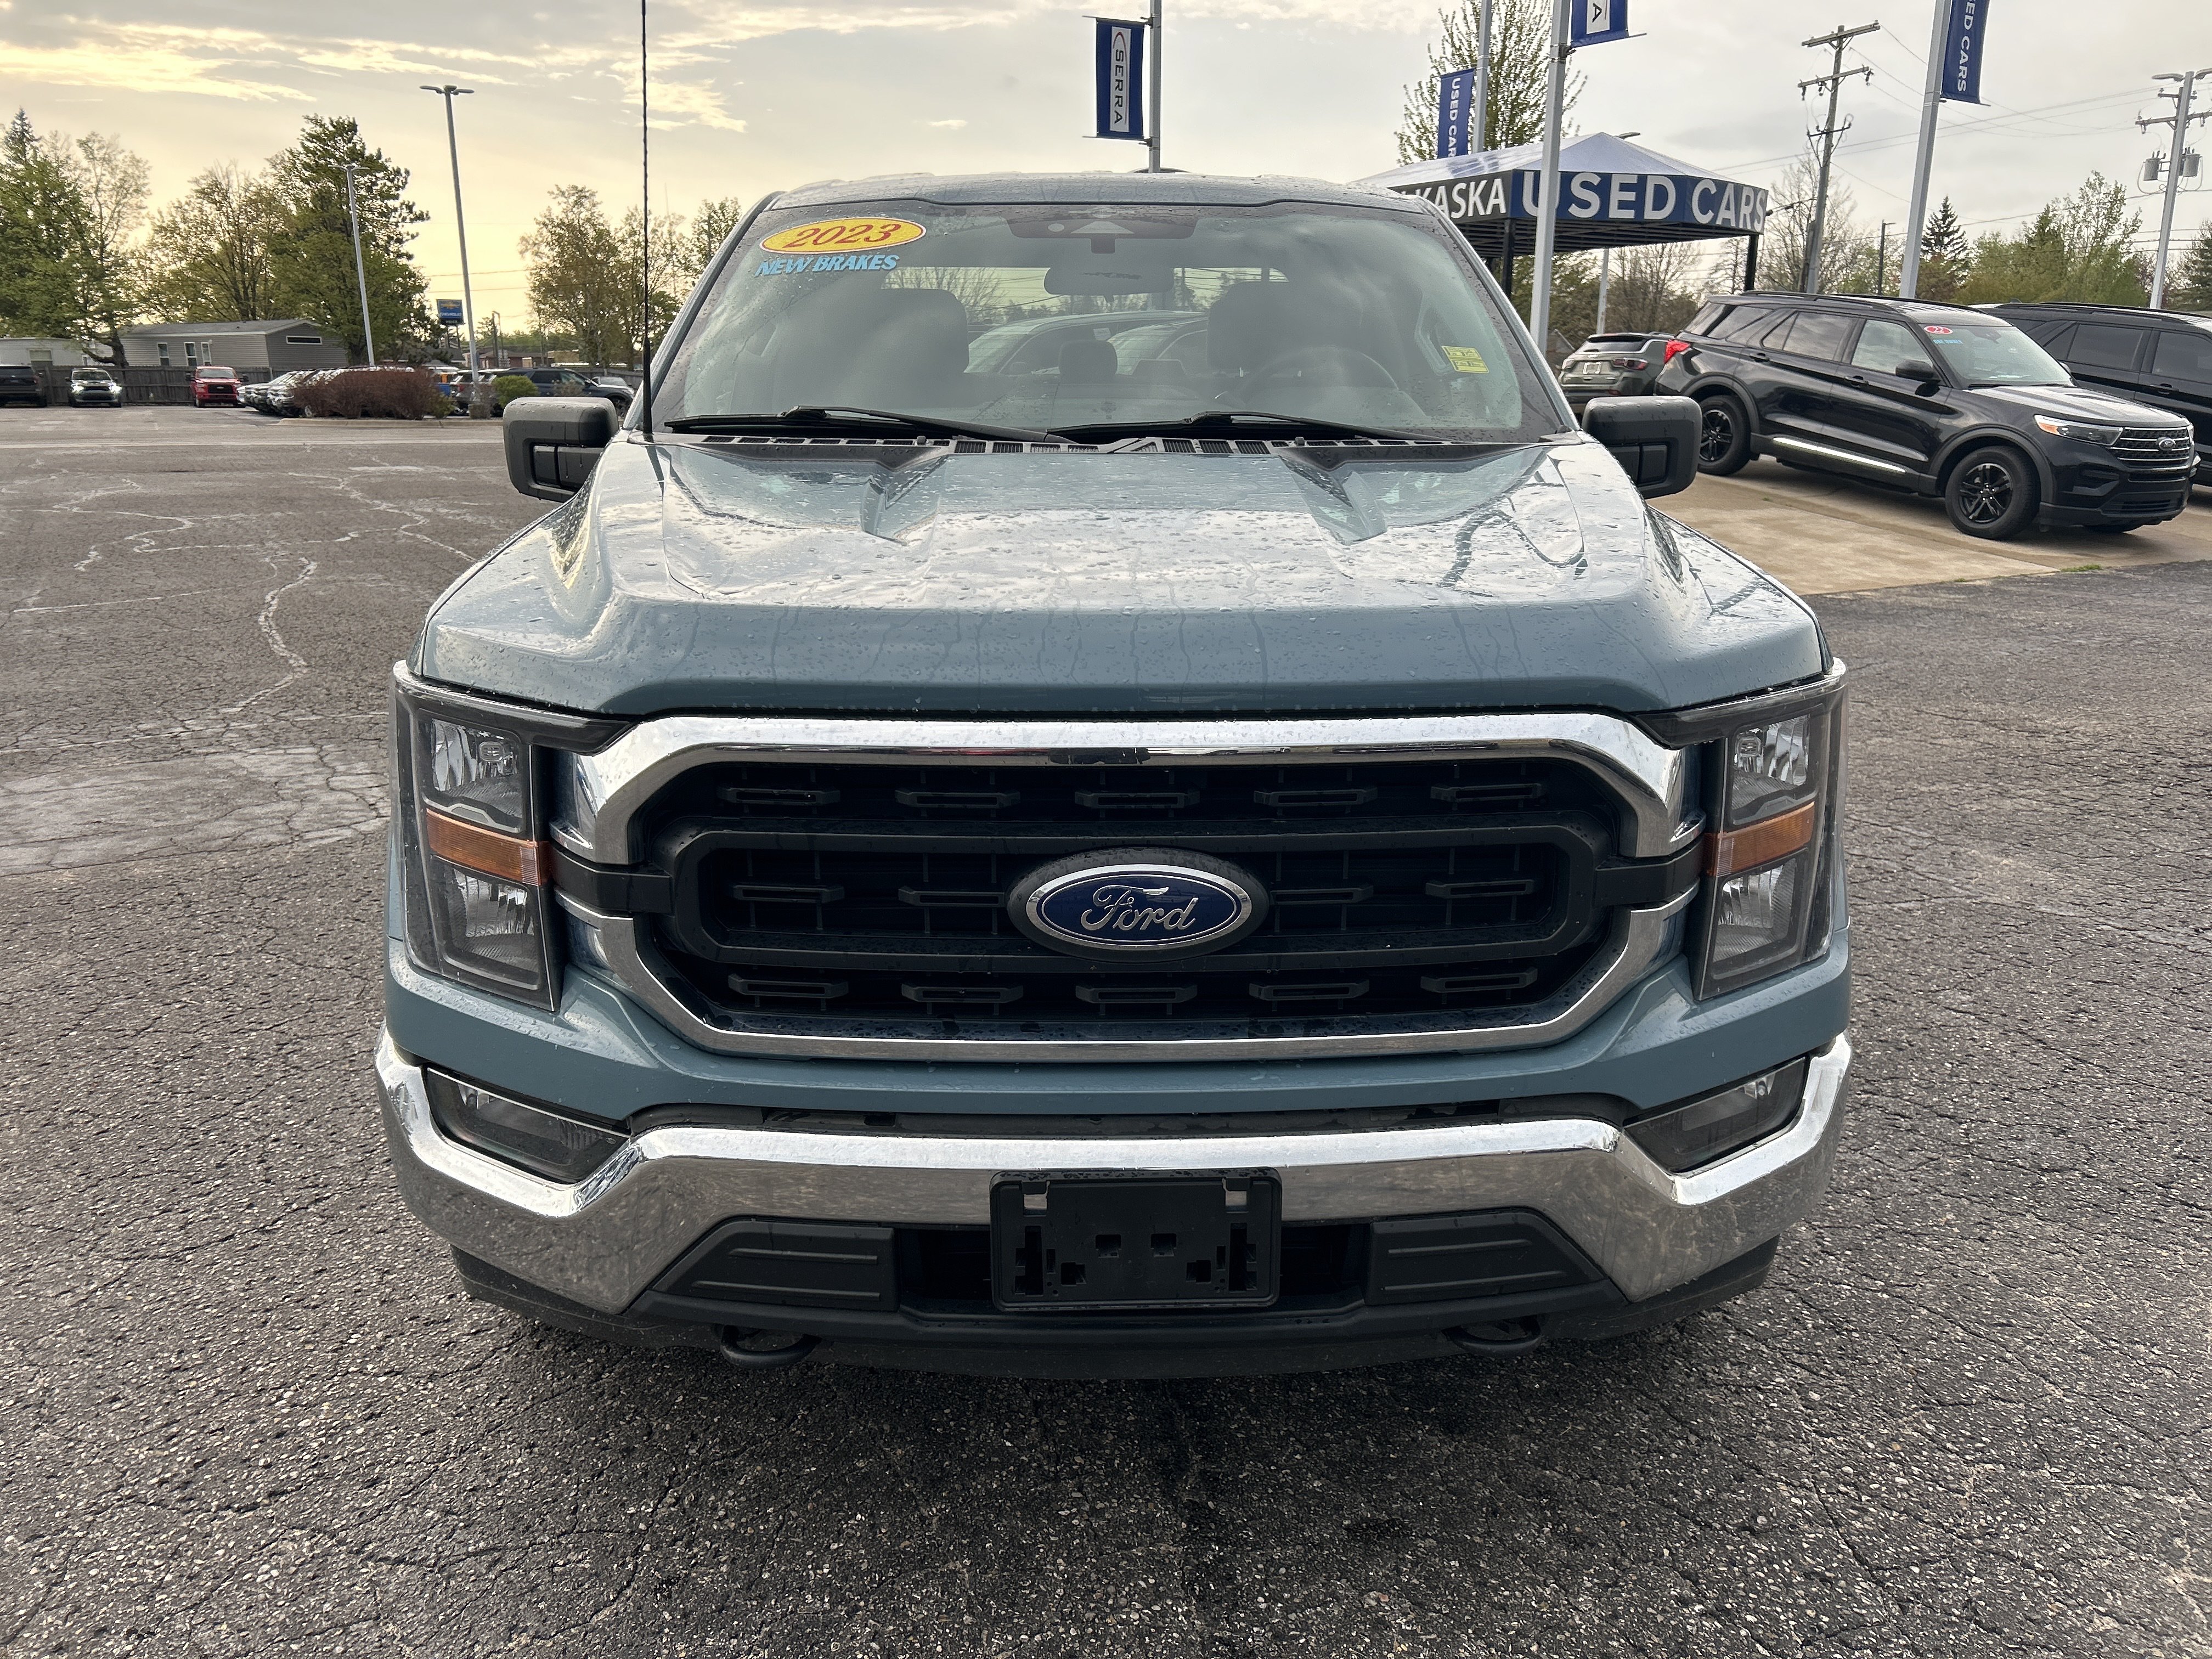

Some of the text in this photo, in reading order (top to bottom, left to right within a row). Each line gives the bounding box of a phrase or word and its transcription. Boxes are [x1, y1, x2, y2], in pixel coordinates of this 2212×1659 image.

[1957, 0, 1976, 92] ED CARS
[1114, 49, 1124, 124] SERRA
[1449, 77, 1462, 121] USED
[1691, 179, 1768, 233] CARS
[782, 223, 902, 249] 2023
[754, 255, 900, 278] NEW BRAKES
[1080, 884, 1199, 931] Ford
